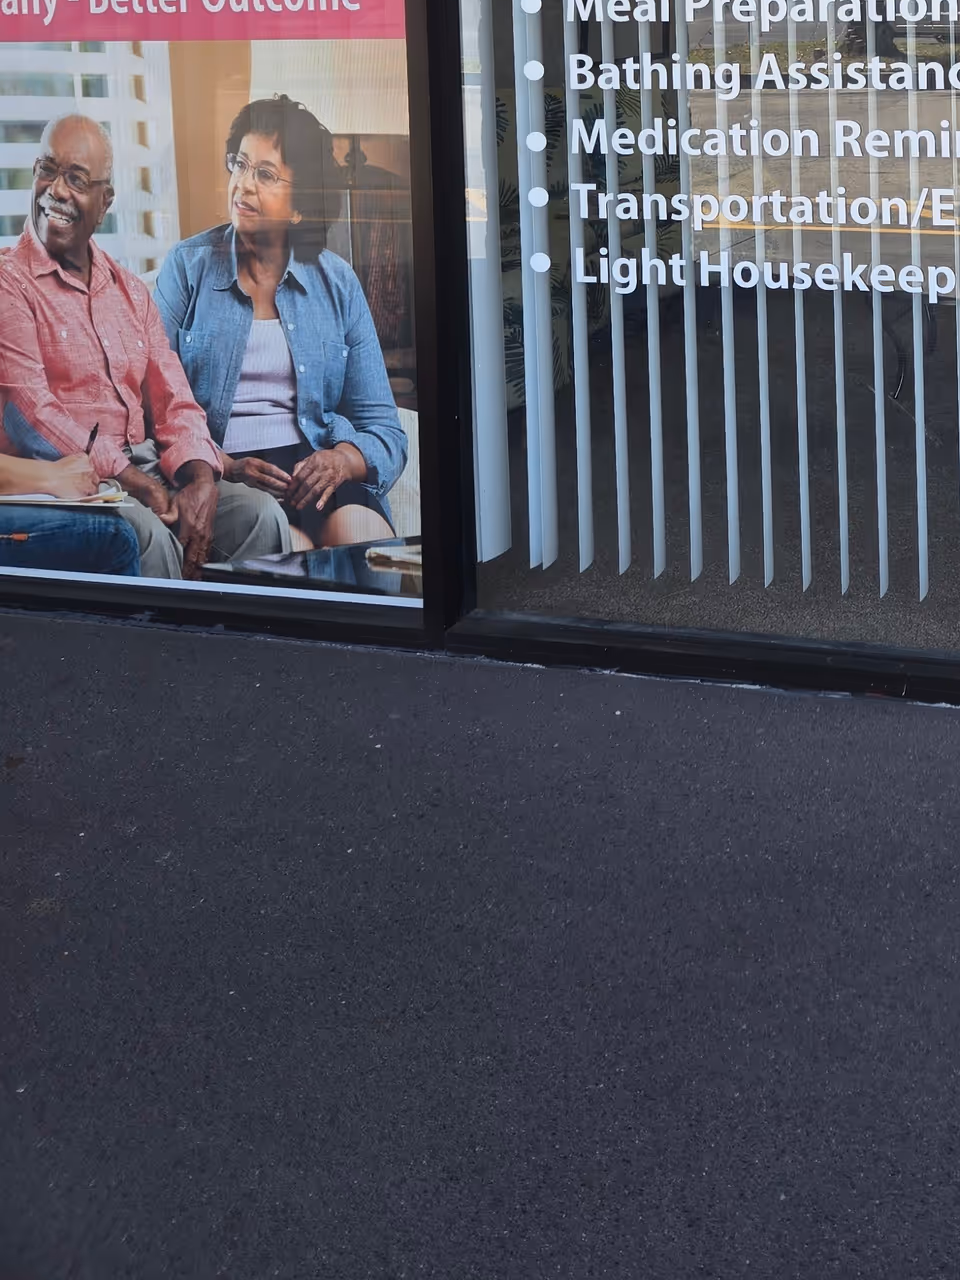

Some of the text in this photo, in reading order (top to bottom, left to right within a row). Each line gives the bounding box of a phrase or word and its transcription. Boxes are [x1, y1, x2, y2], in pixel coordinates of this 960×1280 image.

[568, 53, 741, 101] Bathing
[571, 118, 819, 157] Medication
[575, 246, 686, 294] Light
